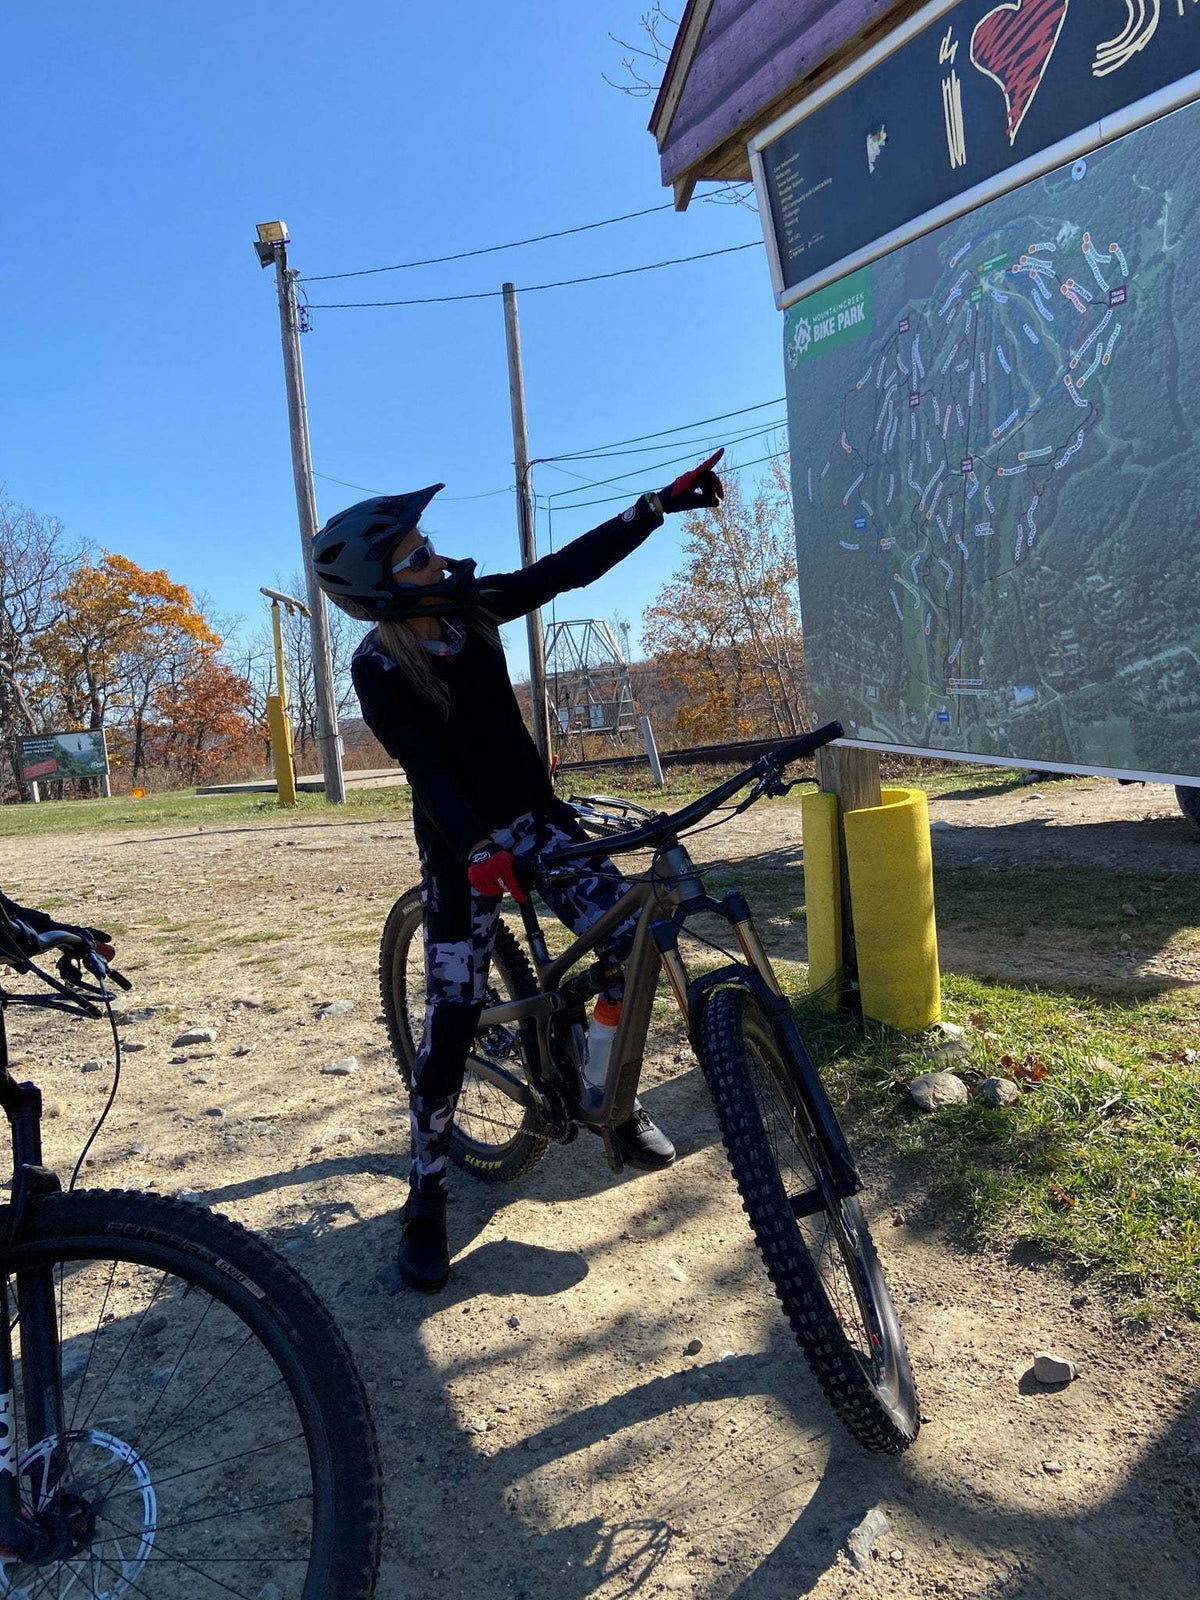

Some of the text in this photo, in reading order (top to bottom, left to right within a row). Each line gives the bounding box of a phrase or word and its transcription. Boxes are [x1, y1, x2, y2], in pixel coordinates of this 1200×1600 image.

[1111, 294, 1125, 304] HUB
[813, 302, 865, 342] BIKE PARK
[464, 1153, 503, 1170] MAXXIS
[216, 1259, 246, 1285] GRID
